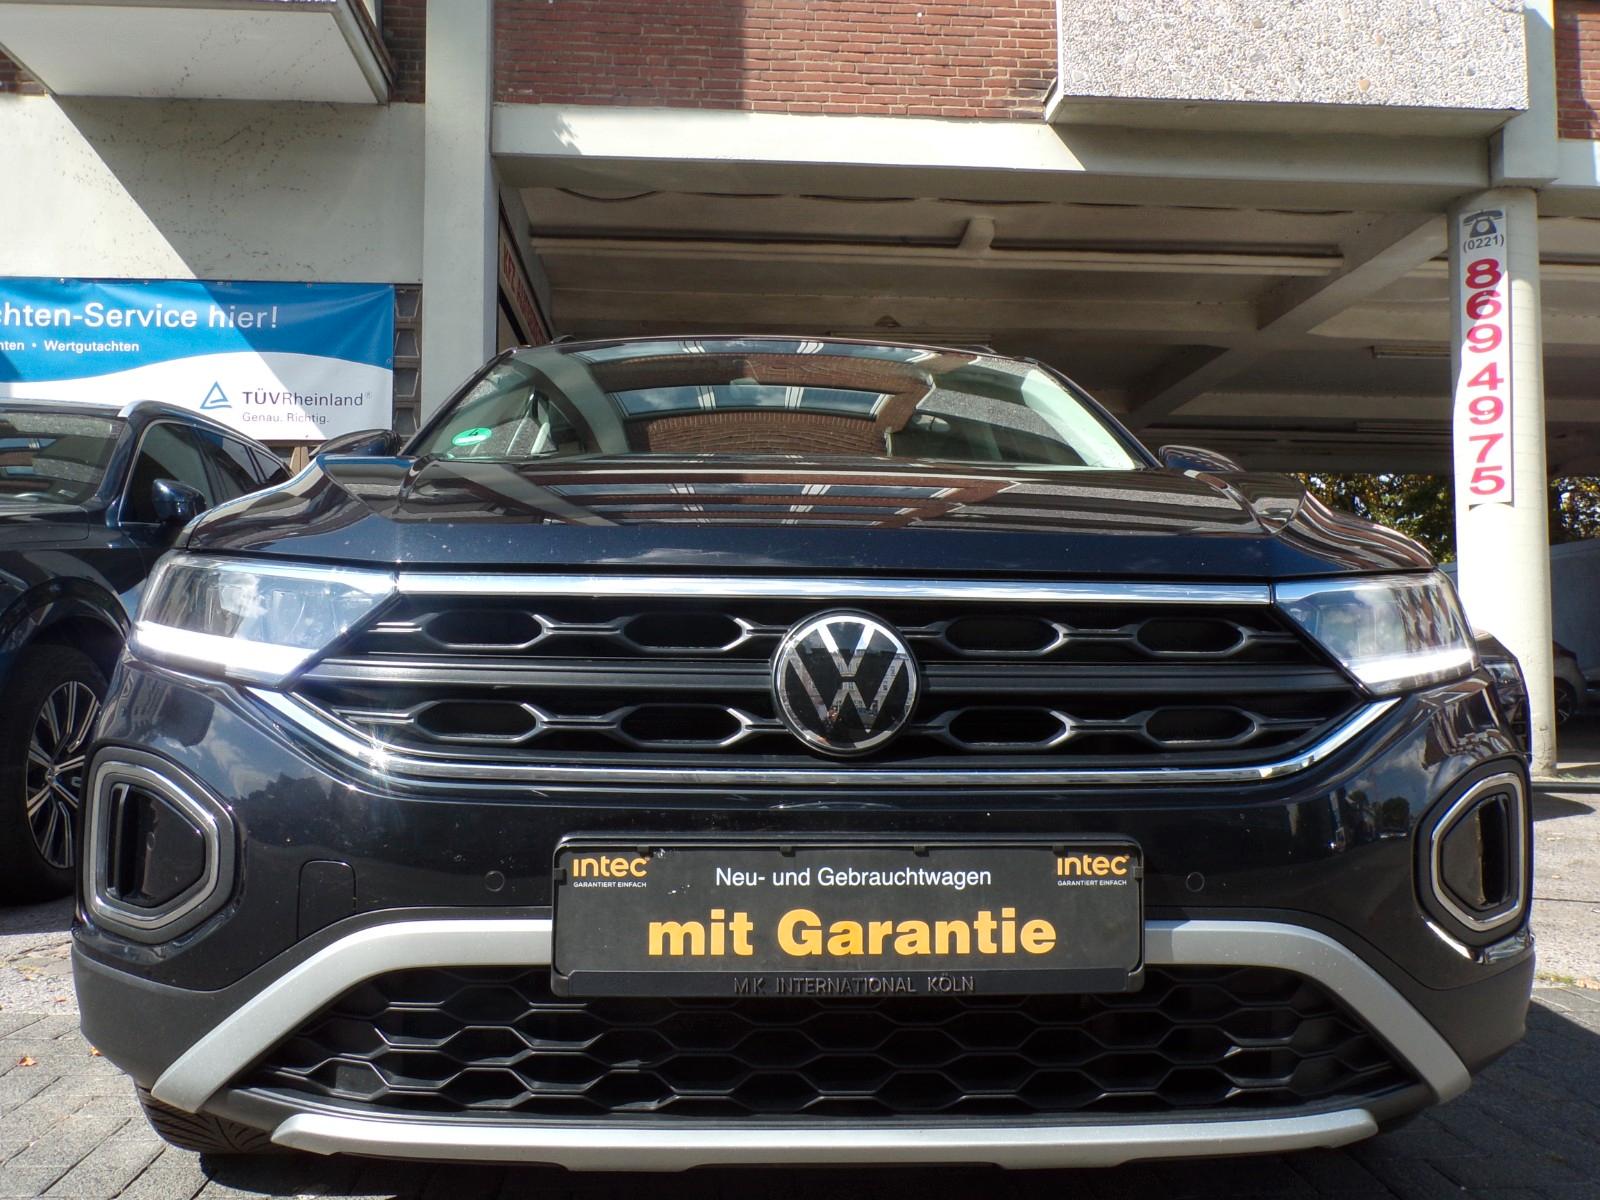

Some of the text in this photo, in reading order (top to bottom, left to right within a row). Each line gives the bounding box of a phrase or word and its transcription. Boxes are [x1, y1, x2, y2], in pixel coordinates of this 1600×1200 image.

[1463, 234, 1505, 254] (0221)
[0, 302, 278, 329] hten-Service hier!
[44, 340, 140, 354] Wertgutachten
[242, 412, 330, 425] Genau. Richtig.
[572, 856, 648, 878] intec
[1057, 854, 1128, 877] intec
[715, 866, 993, 891] Neu- und Gebrauchtwagen
[648, 906, 1058, 958] mit Garantie
[776, 976, 917, 994] INTERNATIONAL
[927, 972, 974, 993] KÖLN
